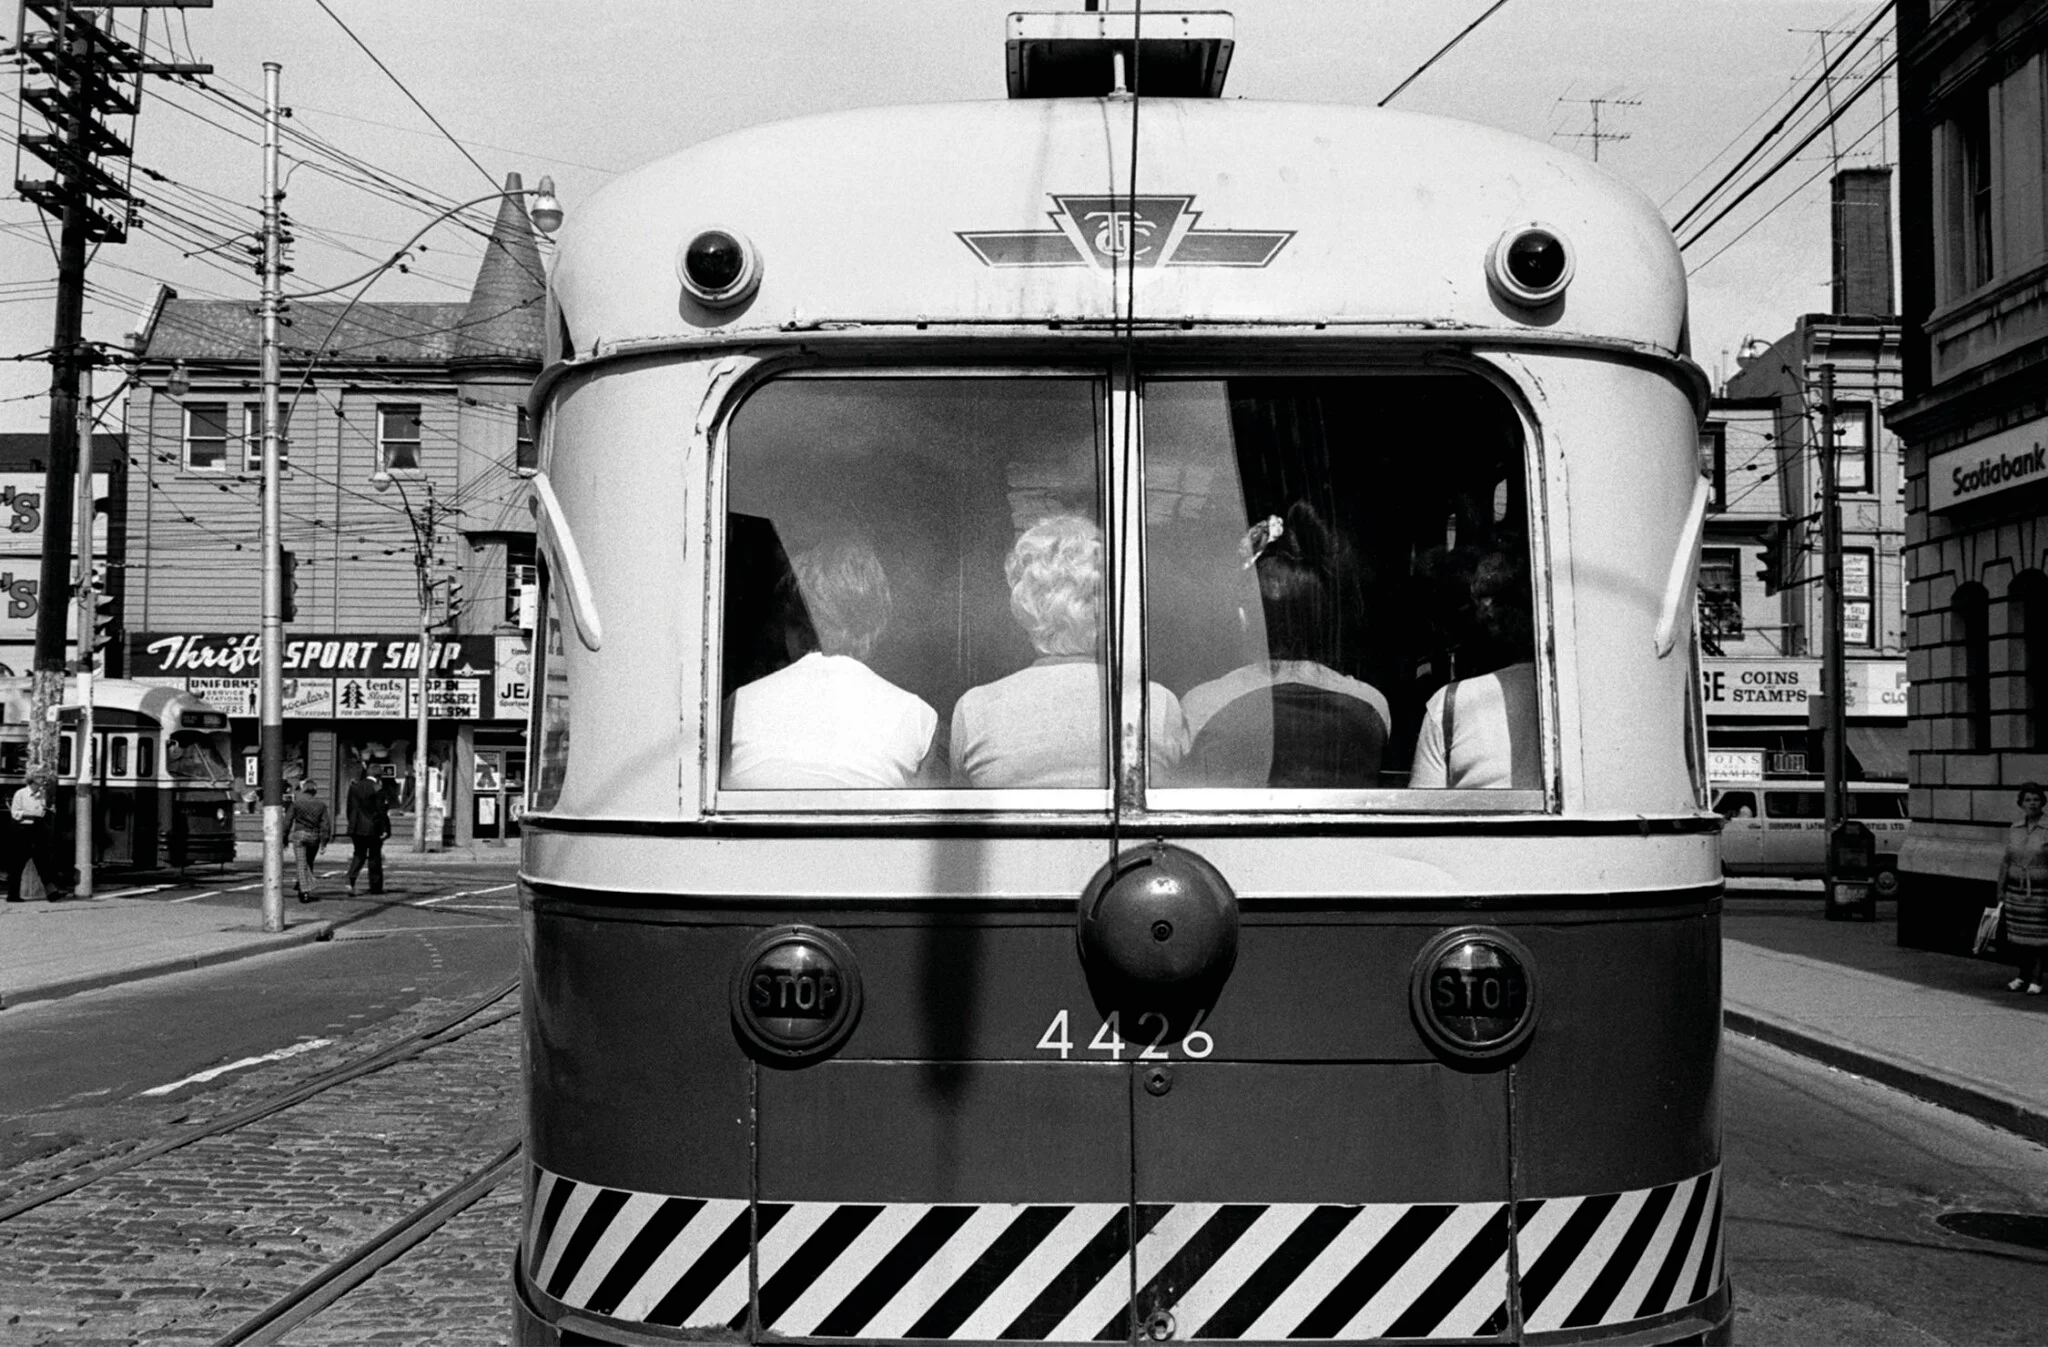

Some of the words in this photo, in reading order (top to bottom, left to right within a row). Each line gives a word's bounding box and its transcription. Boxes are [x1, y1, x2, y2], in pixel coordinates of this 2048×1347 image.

[1952, 441, 2046, 497] Scotiabank
[282, 641, 379, 669] SPORT
[191, 679, 259, 689] UNIFORMS
[1741, 671, 1799, 684] COINS
[1733, 689, 1807, 702] STAMPS
[247, 759, 255, 783] FIRE
[1711, 755, 1760, 764] OINS
[754, 974, 836, 1010] STOP
[1035, 1009, 1215, 1060] 4426
